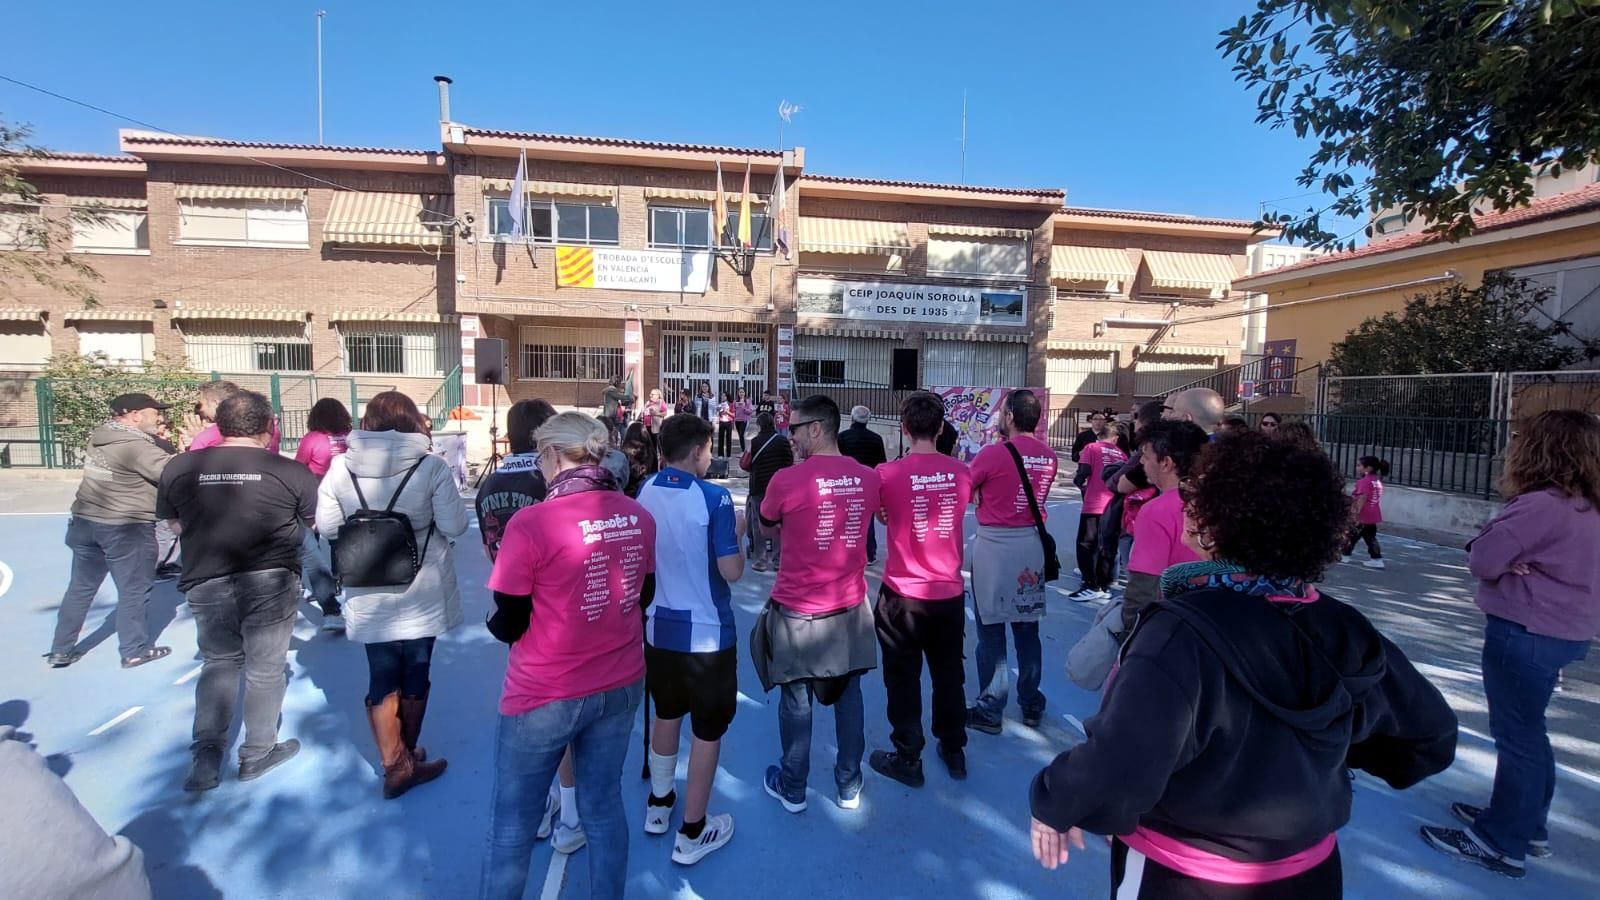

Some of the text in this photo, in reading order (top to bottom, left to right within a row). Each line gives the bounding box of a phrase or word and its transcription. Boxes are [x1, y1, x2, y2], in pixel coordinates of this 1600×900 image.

[599, 253, 686, 265] TROBADA D'ESCOLES
[597, 264, 608, 272] EN
[597, 274, 608, 283] DE
[849, 289, 975, 303] CEIP JOAQUÍN SOROLLA
[876, 305, 948, 316] DES DE 1935
